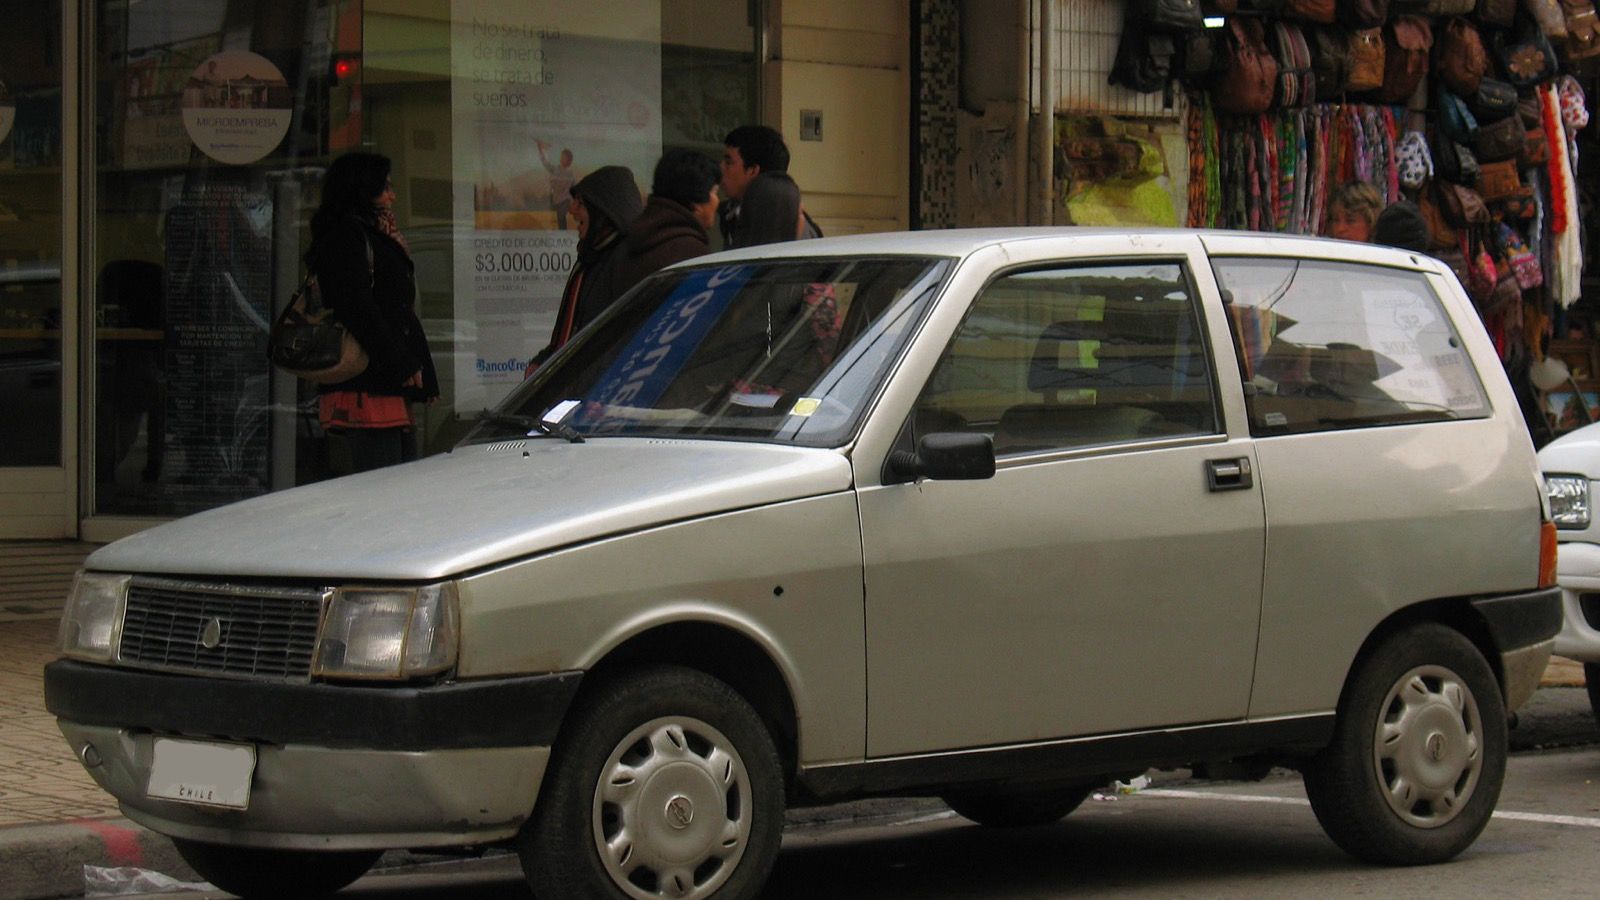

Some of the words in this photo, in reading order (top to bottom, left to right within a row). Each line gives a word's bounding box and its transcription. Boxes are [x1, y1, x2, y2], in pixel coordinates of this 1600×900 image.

[535, 65, 554, 86] de
[197, 117, 278, 128] MICROEMPRESA
[475, 252, 572, 272] $3.000.000
[178, 784, 213, 800] CHILE
